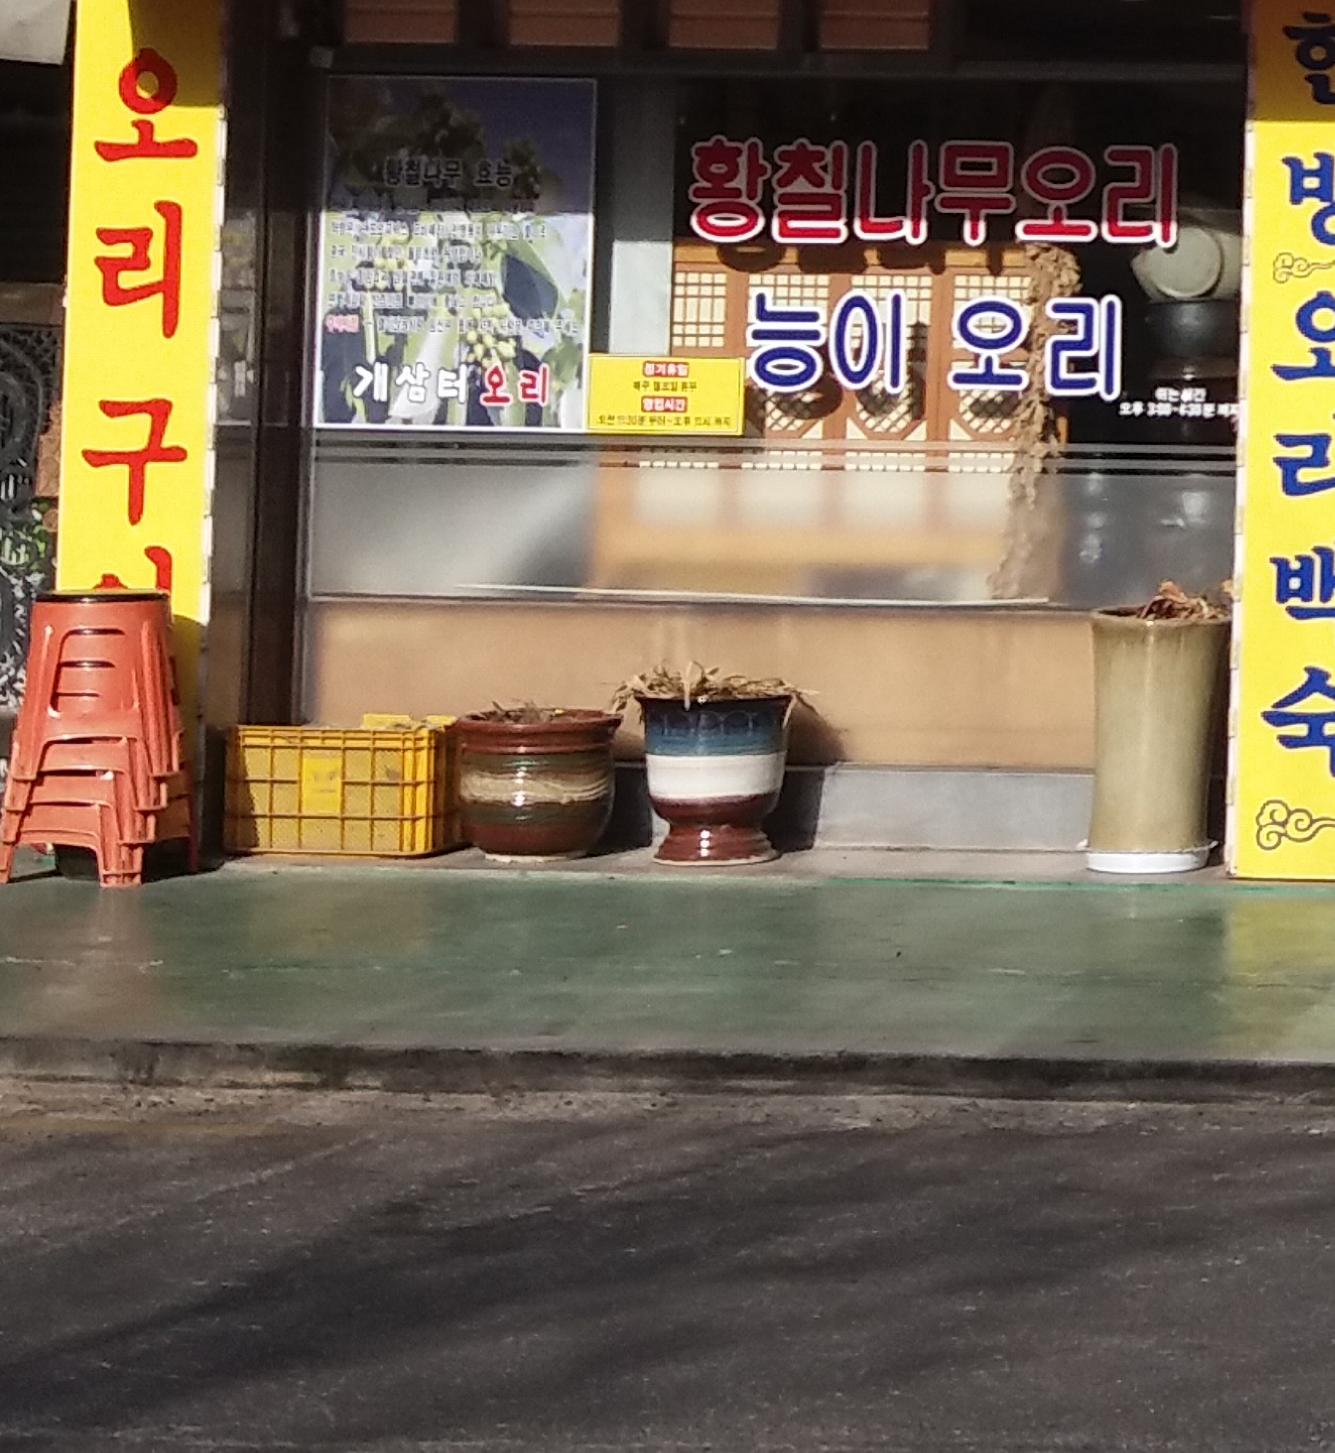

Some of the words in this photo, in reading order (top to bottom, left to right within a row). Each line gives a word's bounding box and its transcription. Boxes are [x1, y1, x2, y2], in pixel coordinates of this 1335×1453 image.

[687, 135, 1179, 247] 황칠나무오리
[81, 47, 198, 593] 오리구
[746, 288, 906, 395] 능이
[947, 294, 1122, 401] 오리
[353, 361, 470, 405] 개삼터
[478, 363, 552, 408] 오리
